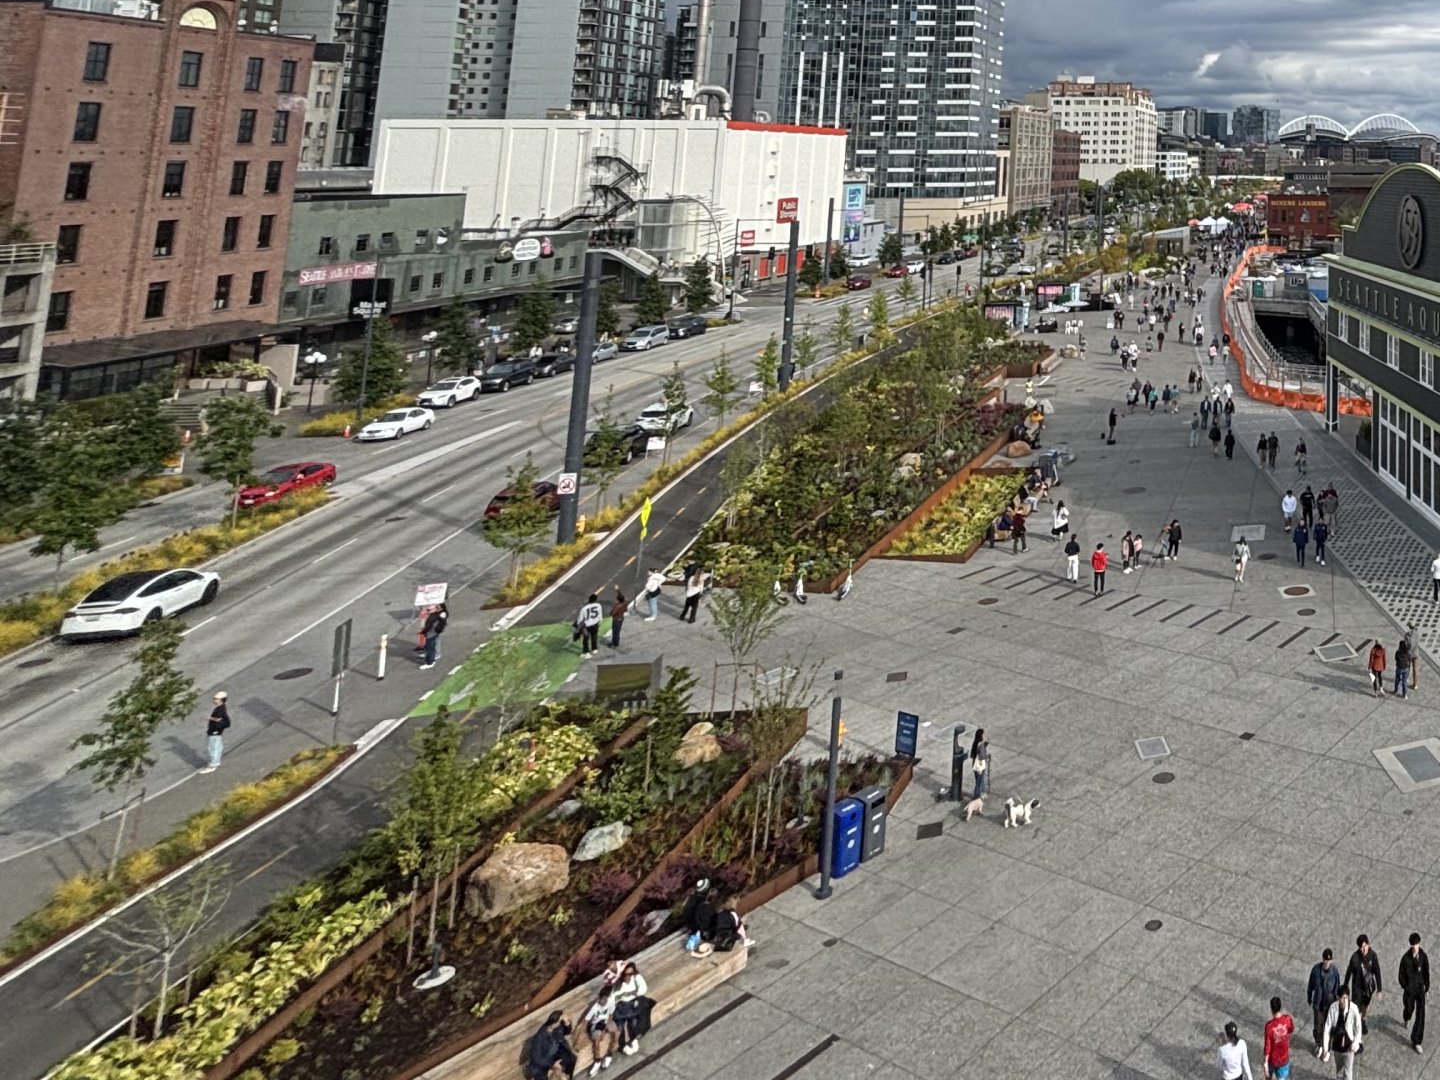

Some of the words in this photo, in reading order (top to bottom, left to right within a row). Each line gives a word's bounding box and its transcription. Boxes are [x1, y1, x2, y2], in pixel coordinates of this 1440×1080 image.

[782, 201, 797, 210] Public
[1338, 277, 1399, 320] SEATTLE
[352, 307, 382, 315] Squre
[586, 606, 599, 620] 15
